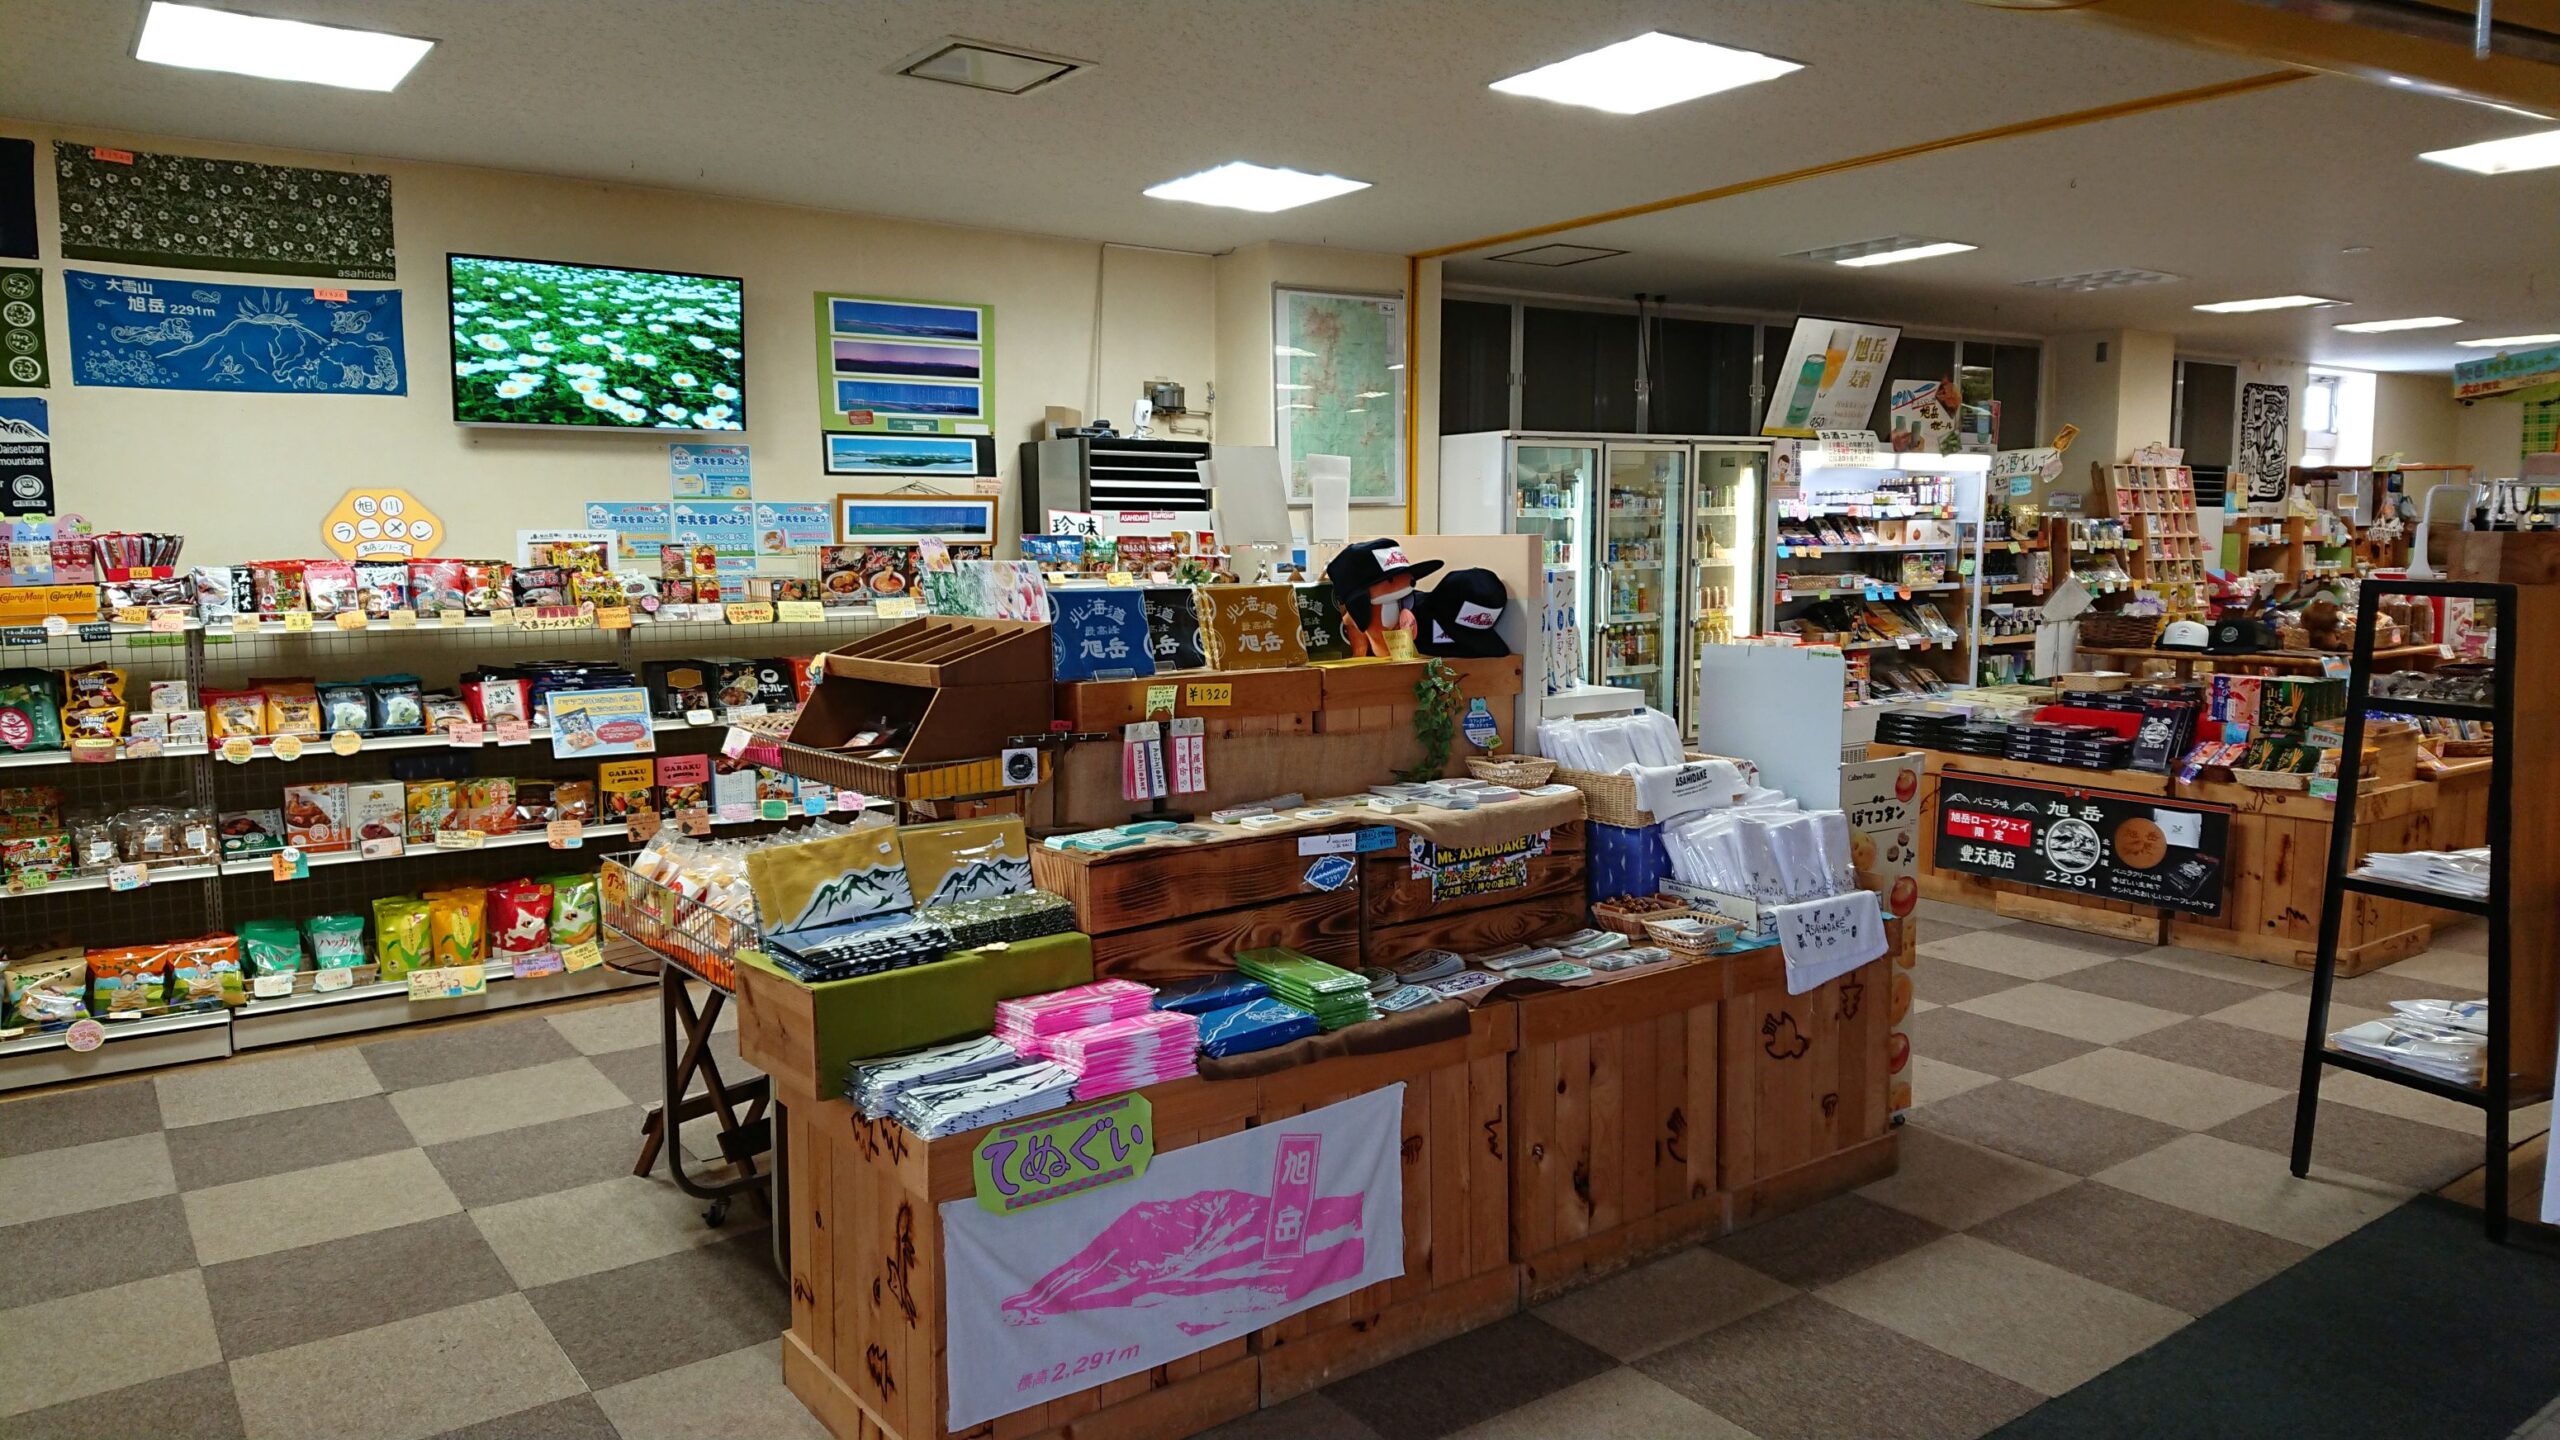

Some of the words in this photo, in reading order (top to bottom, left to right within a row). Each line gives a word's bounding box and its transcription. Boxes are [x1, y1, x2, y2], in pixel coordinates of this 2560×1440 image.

[337, 269, 394, 280] asahidake
[106, 280, 153, 296] 大雪山
[128, 296, 165, 314] 旭岳
[170, 304, 216, 318] 2291m
[1821, 431, 1875, 440] お酒コーナー
[358, 499, 400, 514] 旭川
[611, 515, 670, 524] 牛乳を食べよう!
[677, 514, 752, 526] 牛乳を食べよう!
[777, 516, 830, 524] 牛乳を食べよう!
[1052, 515, 1099, 535] 珍味
[337, 522, 432, 539] ラーメン
[361, 544, 407, 553] 名店シリーズ
[1069, 598, 1127, 629] 北海道
[1227, 595, 1279, 624] 北海道
[157, 622, 178, 630] ¥60
[1085, 625, 1120, 637] 最高峰
[1080, 638, 1130, 659] 旭岳
[1238, 632, 1284, 652] 旭岳
[759, 684, 788, 693] 牛カレー
[1189, 687, 1228, 699] ¥1320
[608, 769, 647, 777] GARAKU
[664, 764, 702, 772] GARAKU
[1676, 769, 1707, 787] ASAHIDAKE
[1973, 797, 2010, 810] バニラ味
[1852, 806, 1905, 827] ぽてコタン
[2047, 801, 2104, 823] 旭岳
[1951, 812, 2030, 833] 旭岳ロープウェイ
[1974, 826, 2004, 841] 限定
[1437, 851, 1456, 865] Mt.
[1459, 838, 1527, 860] ASAHIDAKE
[1326, 874, 1341, 884] 2291
[2045, 870, 2097, 889] 2291
[981, 1116, 1145, 1196] てぬぐい
[1274, 1150, 1310, 1243] 旭岳
[1016, 1367, 1049, 1393] 標高
